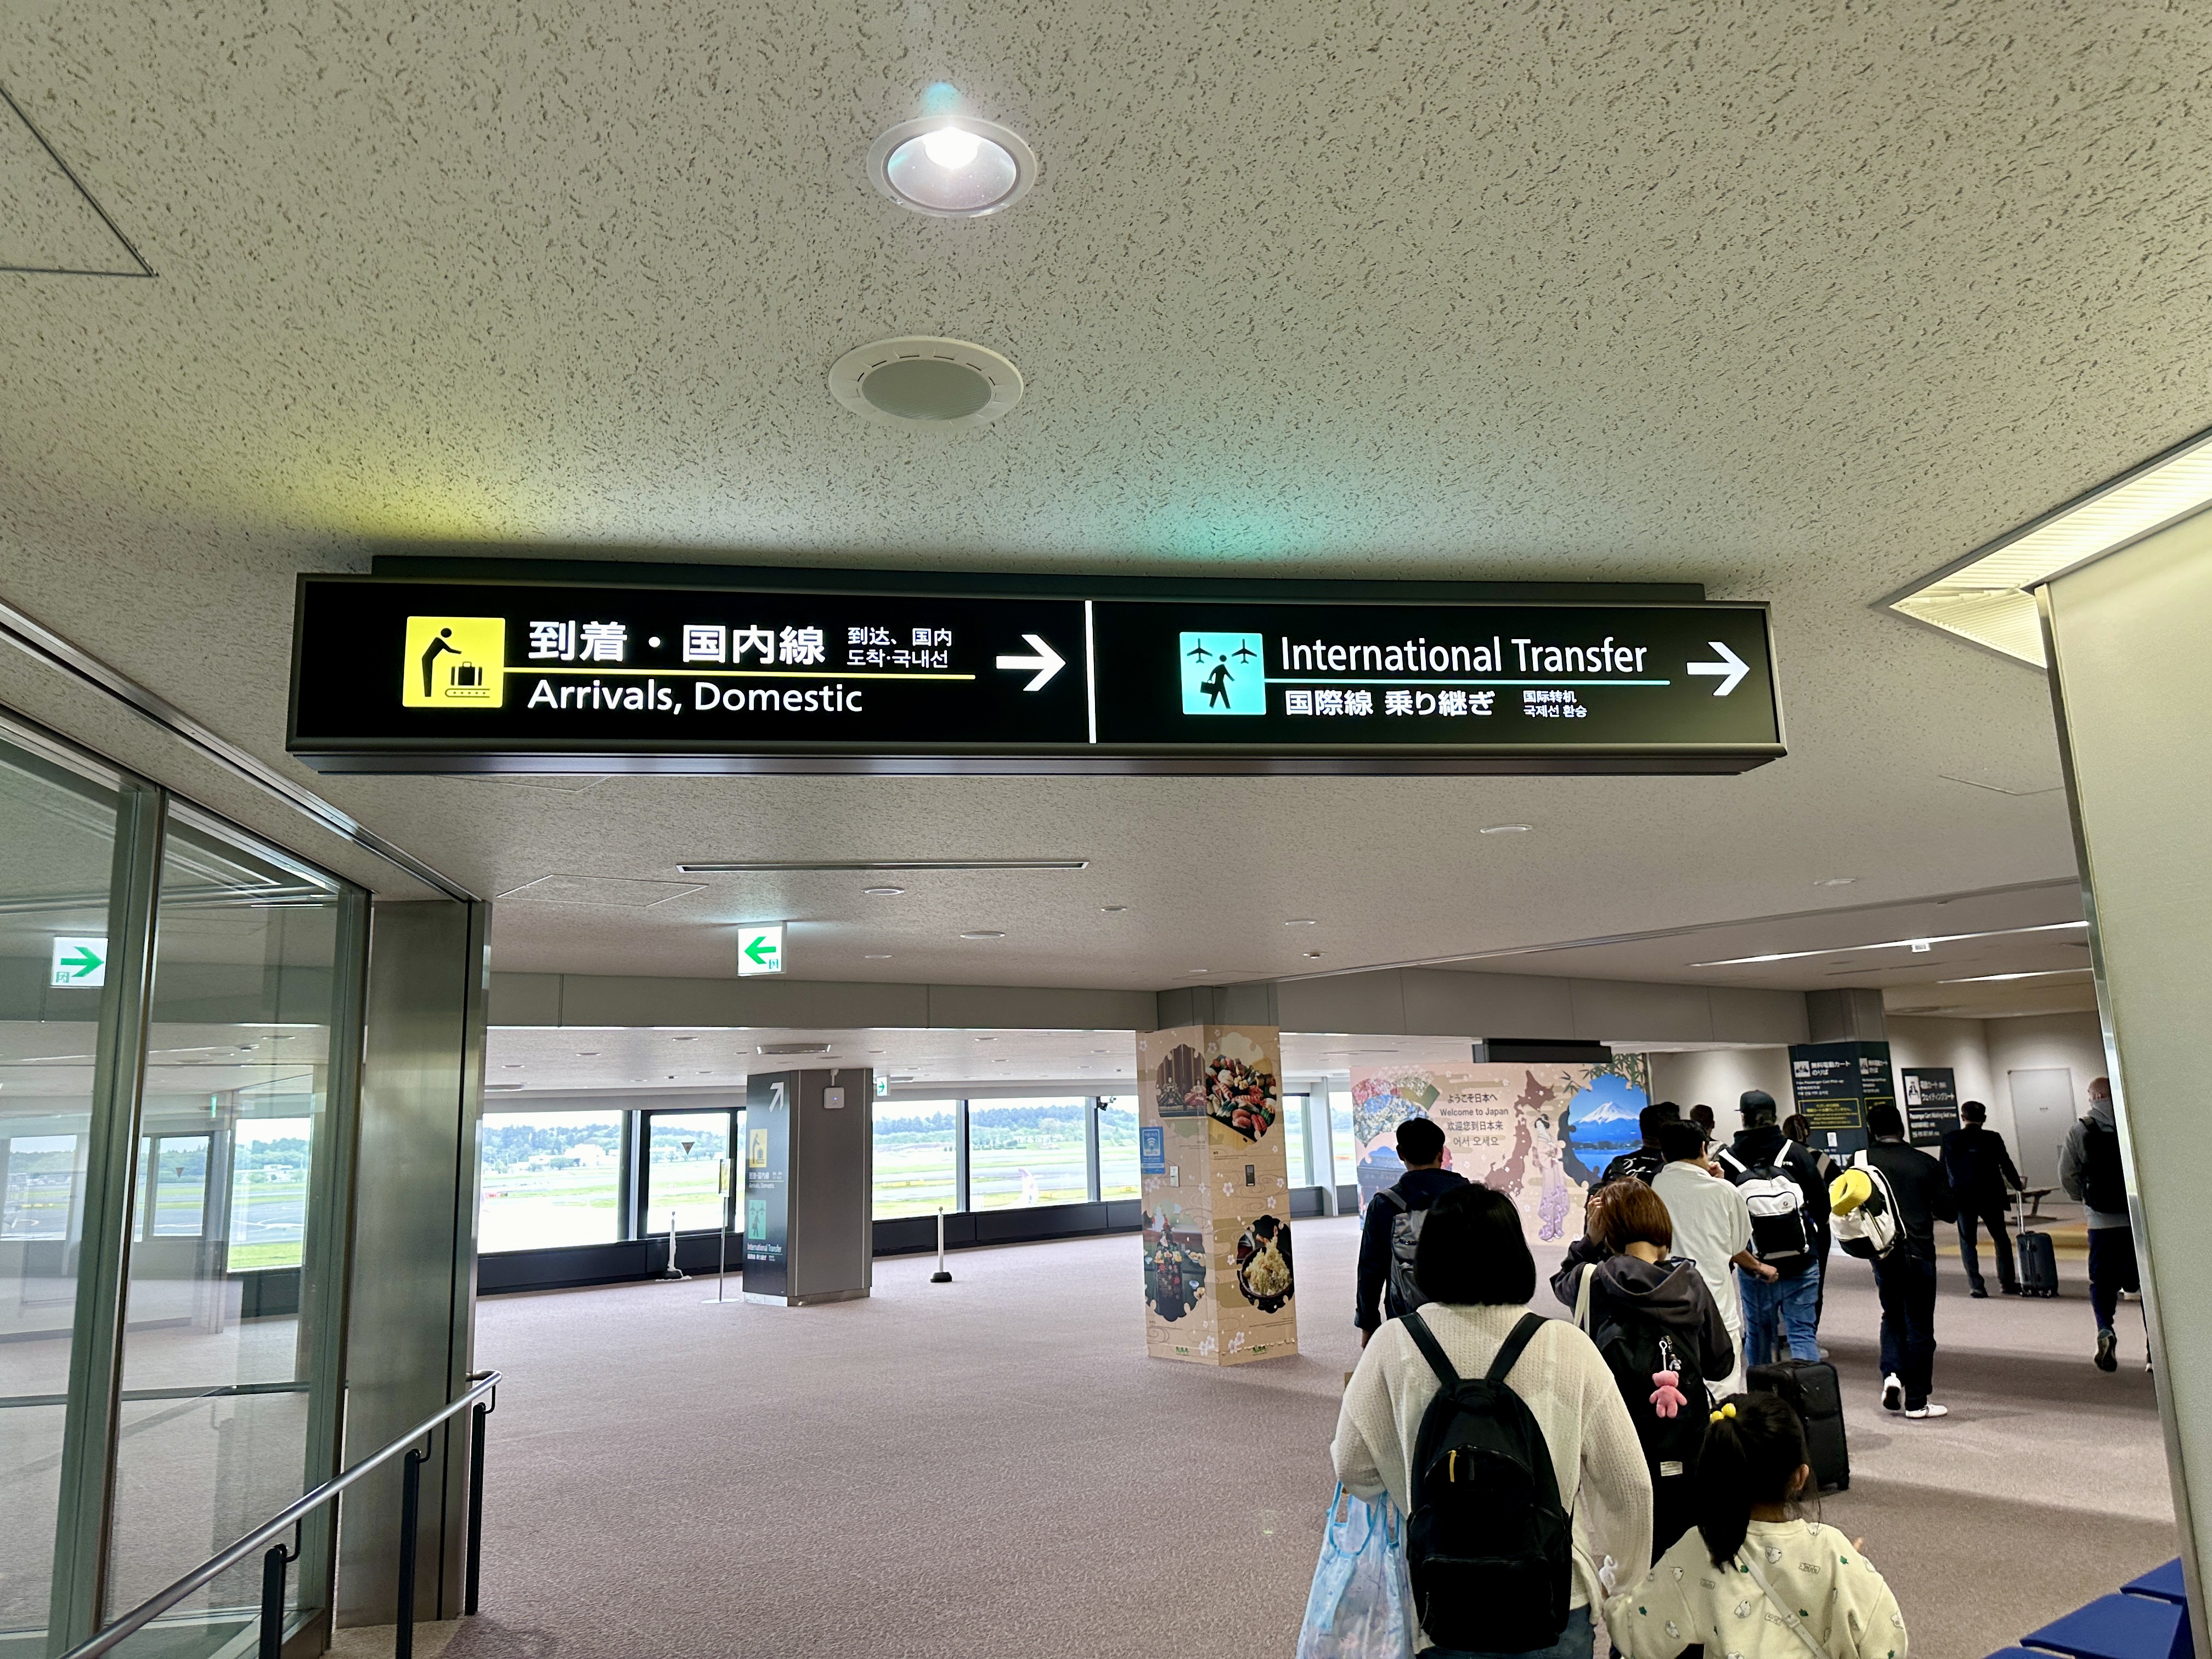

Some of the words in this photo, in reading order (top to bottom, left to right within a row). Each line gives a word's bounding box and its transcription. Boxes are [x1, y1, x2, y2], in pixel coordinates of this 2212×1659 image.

[528, 620, 826, 665] 到着・国内線
[847, 648, 948, 668] 도착·국내선
[1282, 636, 1502, 672] International
[1511, 636, 1647, 673] Transfer
[527, 679, 682, 715] Arrivals,
[695, 681, 862, 712] Domestic
[1285, 690, 1374, 716] 国際線
[1384, 690, 1496, 716] 乗り継ぎ
[1523, 690, 1577, 703] 国际转机
[1523, 704, 1560, 718] 국제선
[1562, 704, 1588, 718] 환승
[1447, 1093, 1498, 1103] ようこそ日本へ
[1485, 1108, 1509, 1116] Japan
[1447, 1120, 1504, 1131] 欢迎您到日本来
[1453, 1136, 1470, 1147] 어서
[1472, 1136, 1499, 1147] 오세요
